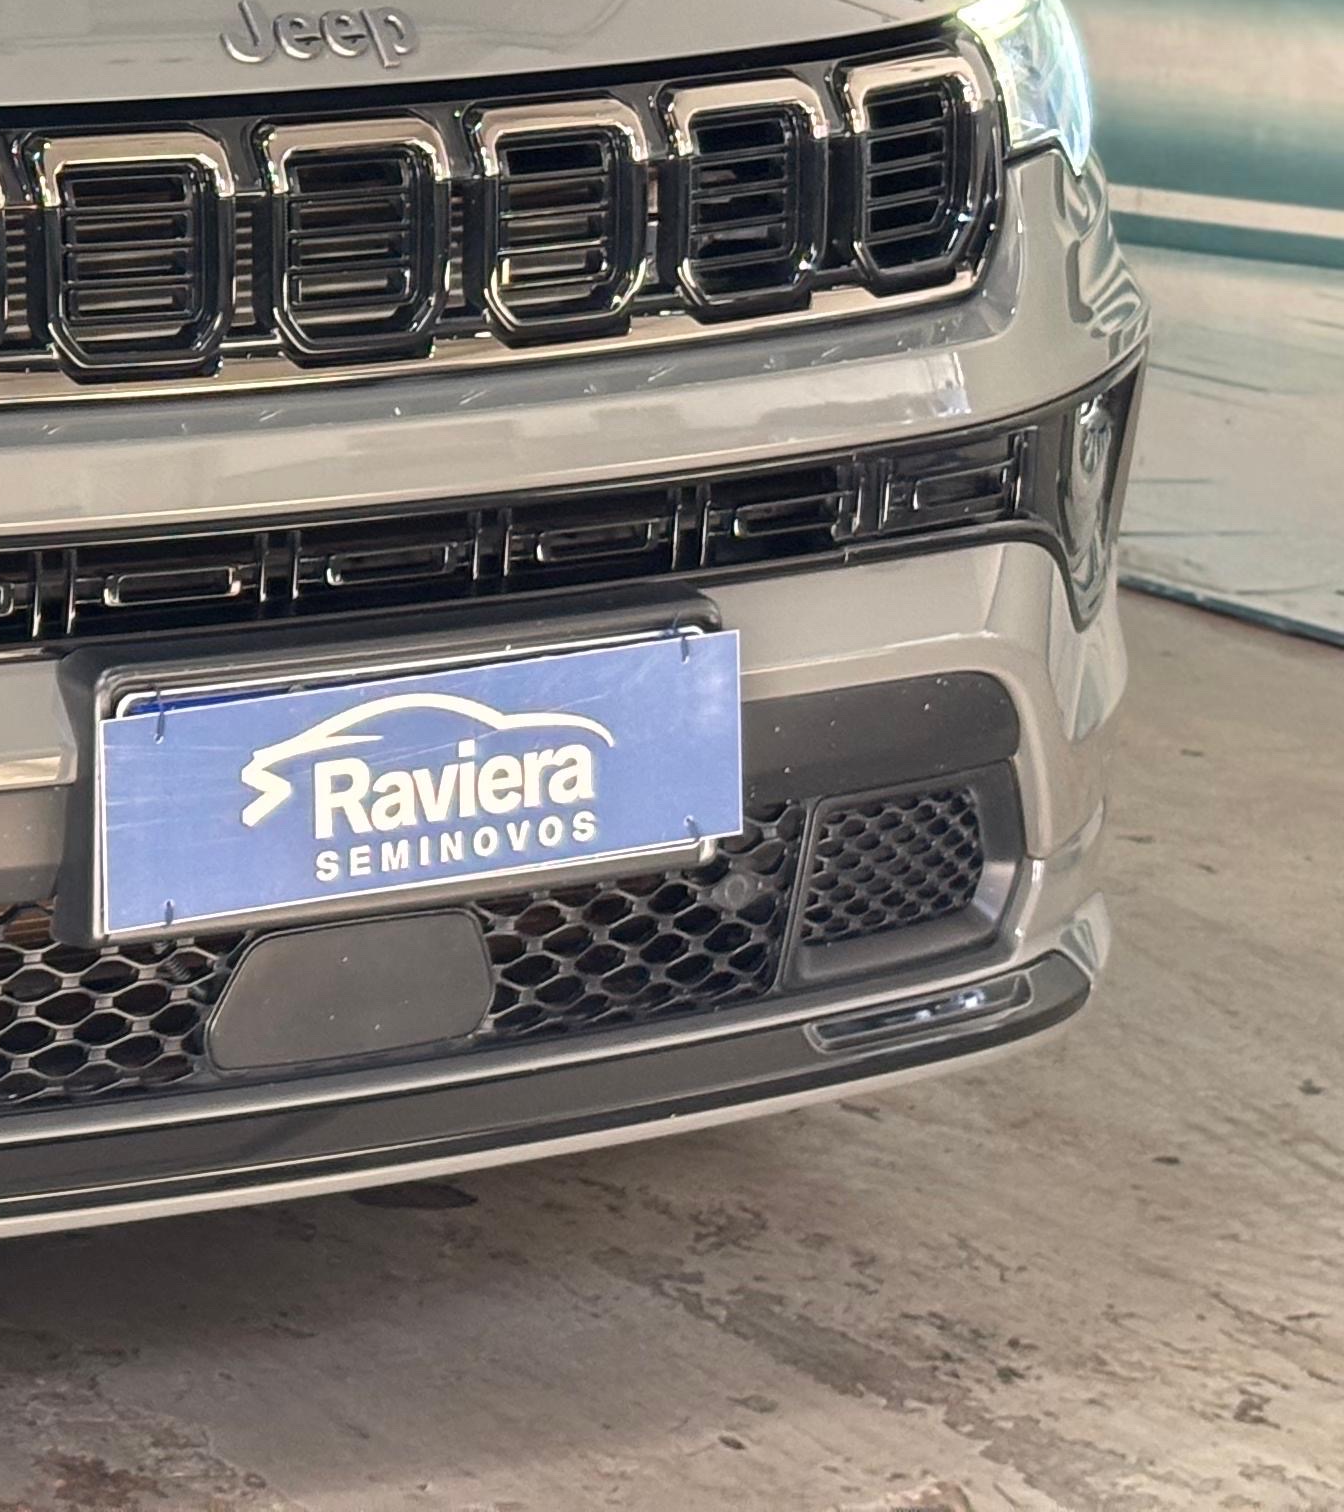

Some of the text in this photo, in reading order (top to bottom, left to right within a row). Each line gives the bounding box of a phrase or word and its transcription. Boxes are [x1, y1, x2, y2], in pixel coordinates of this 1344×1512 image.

[219, 0, 420, 69] Jeep
[314, 739, 593, 839] Raviera
[315, 810, 596, 881] SEMINOVOS
